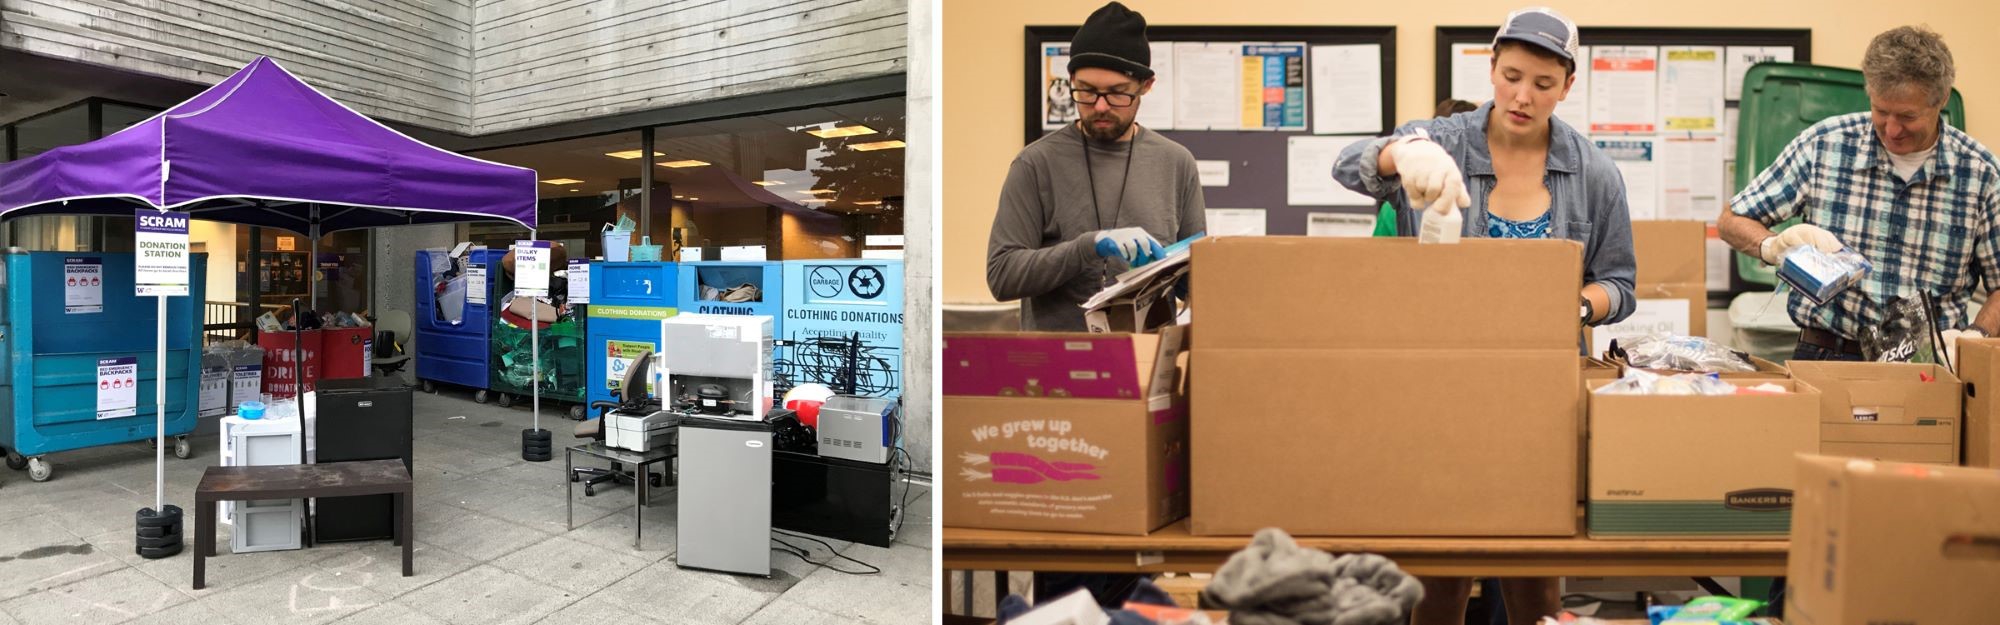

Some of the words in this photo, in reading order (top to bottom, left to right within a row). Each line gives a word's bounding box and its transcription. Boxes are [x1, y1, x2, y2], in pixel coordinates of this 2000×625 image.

[140, 216, 186, 228] SCRAM
[140, 241, 186, 250] DONATION
[144, 250, 182, 258] STATION
[812, 278, 840, 286] GARBAGE
[597, 308, 628, 316] CLOTHING
[629, 309, 667, 317] DONATIONS
[699, 305, 754, 315] CLOTHING
[787, 308, 838, 321] CLOTHING
[841, 311, 903, 324] DONATIONS
[802, 327, 847, 338] Accepting
[275, 348, 307, 362] FOOD
[268, 366, 314, 379] DRIE
[971, 425, 999, 442] We
[1001, 419, 1045, 439] grew
[1048, 419, 1072, 436] up
[1027, 434, 1109, 460] together
[1730, 496, 1776, 504] BANKERS
[1779, 496, 1793, 504] BO
